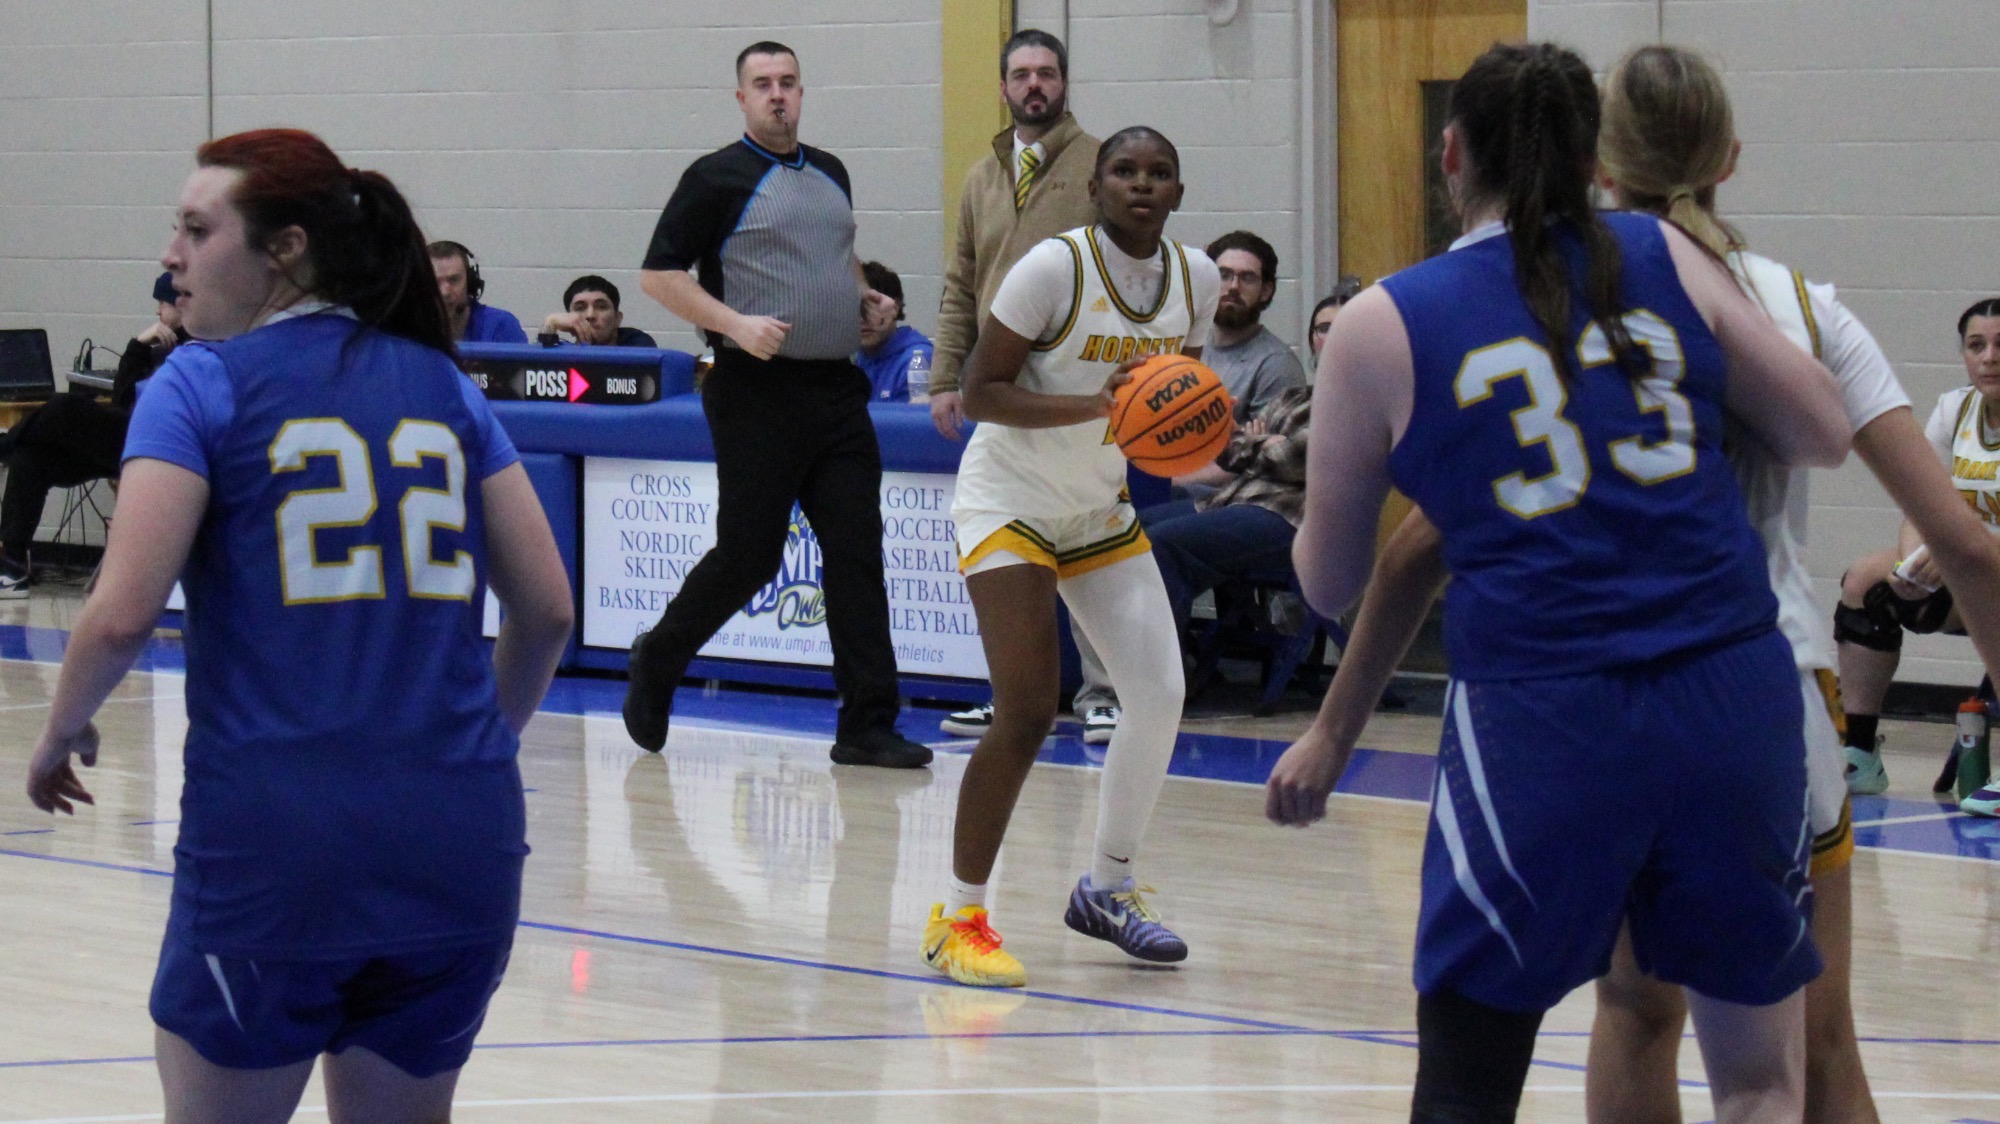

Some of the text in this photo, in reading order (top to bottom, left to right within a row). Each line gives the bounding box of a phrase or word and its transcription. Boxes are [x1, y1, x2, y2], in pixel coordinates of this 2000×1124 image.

[525, 369, 568, 397] POSS
[606, 377, 637, 395] BONUS
[1146, 371, 1199, 413] NCAA
[1156, 396, 1227, 446] Wilson
[1453, 308, 1698, 521] 33
[630, 473, 691, 498] CROSS
[886, 486, 944, 511] GOLF
[267, 416, 477, 606] 22
[611, 498, 710, 524] COUNTRY
[883, 516, 956, 542] OCCER
[620, 530, 702, 557] NORDIC
[882, 547, 956, 573] ASEBAL
[599, 586, 680, 612] BASKET
[884, 577, 971, 604] FTBALL
[891, 607, 981, 636] LEYBAL
[732, 632, 746, 647] at
[749, 634, 833, 655] www.umpi.m
